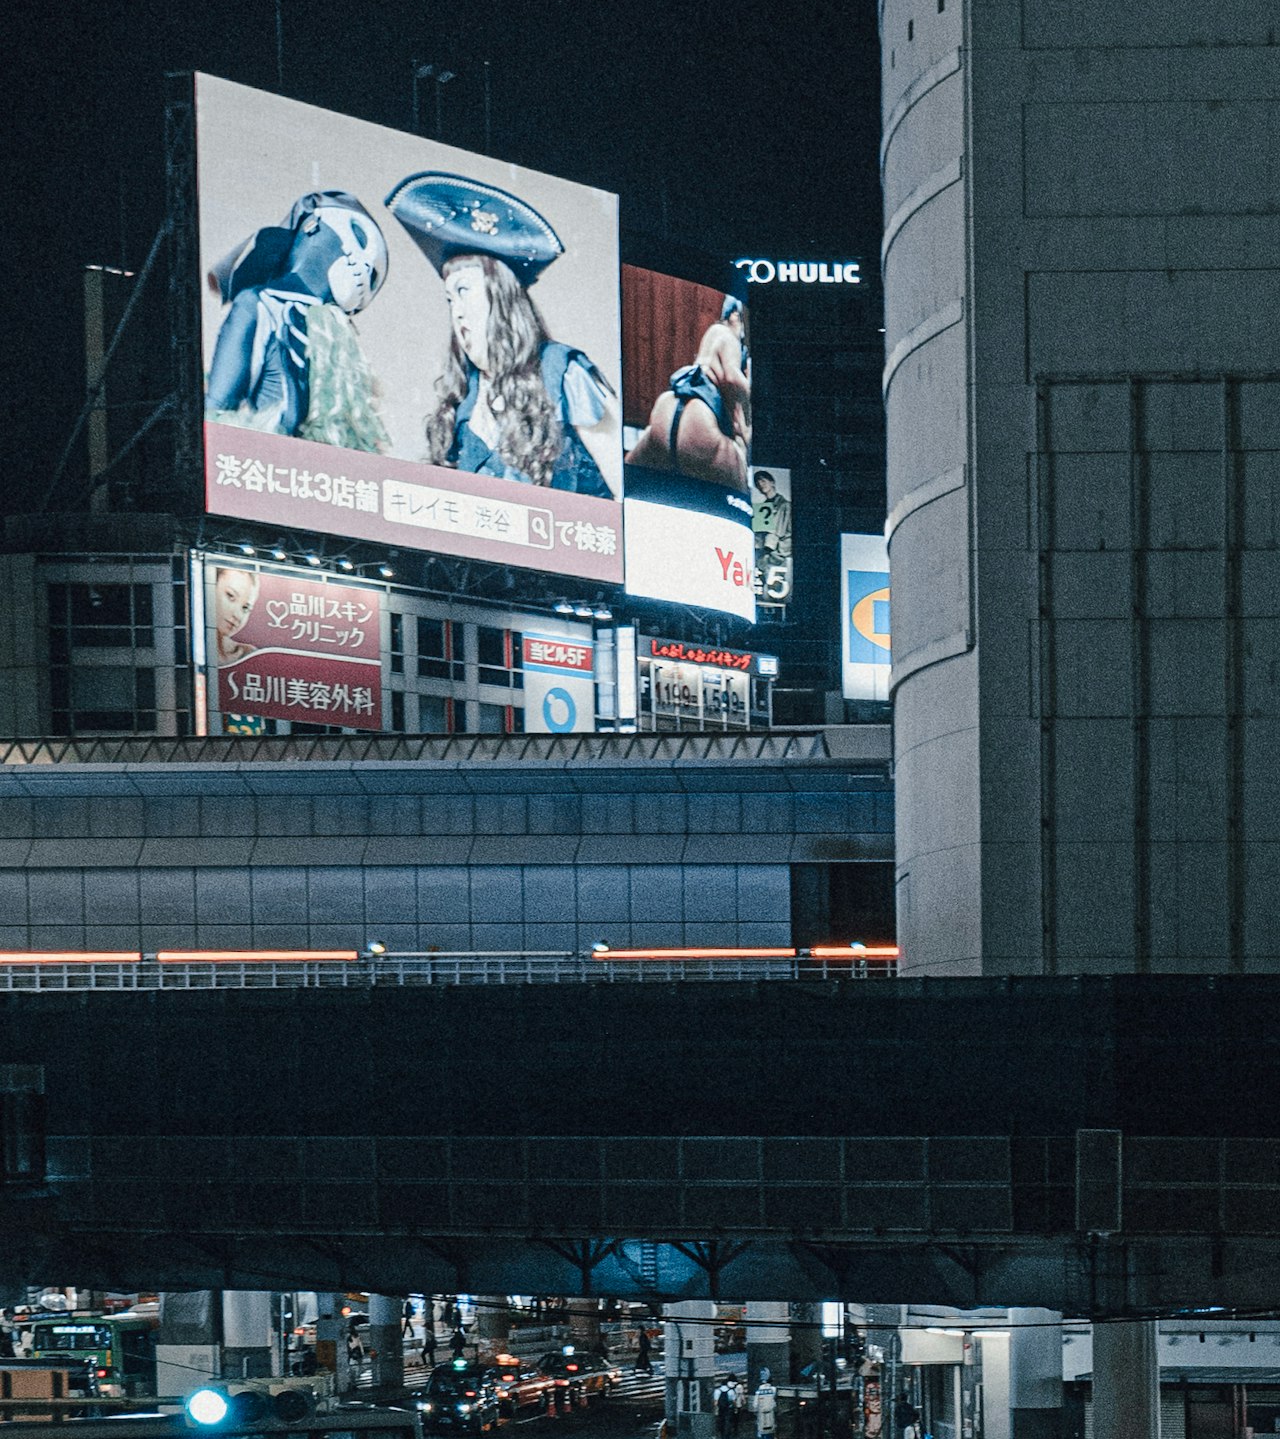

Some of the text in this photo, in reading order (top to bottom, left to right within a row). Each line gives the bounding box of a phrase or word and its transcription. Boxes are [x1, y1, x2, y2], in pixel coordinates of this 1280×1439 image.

[778, 263, 861, 283] HULIC
[215, 453, 618, 556] 渋谷には3店舗 キレイモ 渋谷 で検索
[289, 593, 373, 623] 品川スキン
[291, 621, 365, 648] クリニック
[530, 641, 587, 666] 当ビル5F
[651, 639, 752, 670] しゃぶしゃぶバイキング
[243, 673, 375, 716] 品川美容外科
